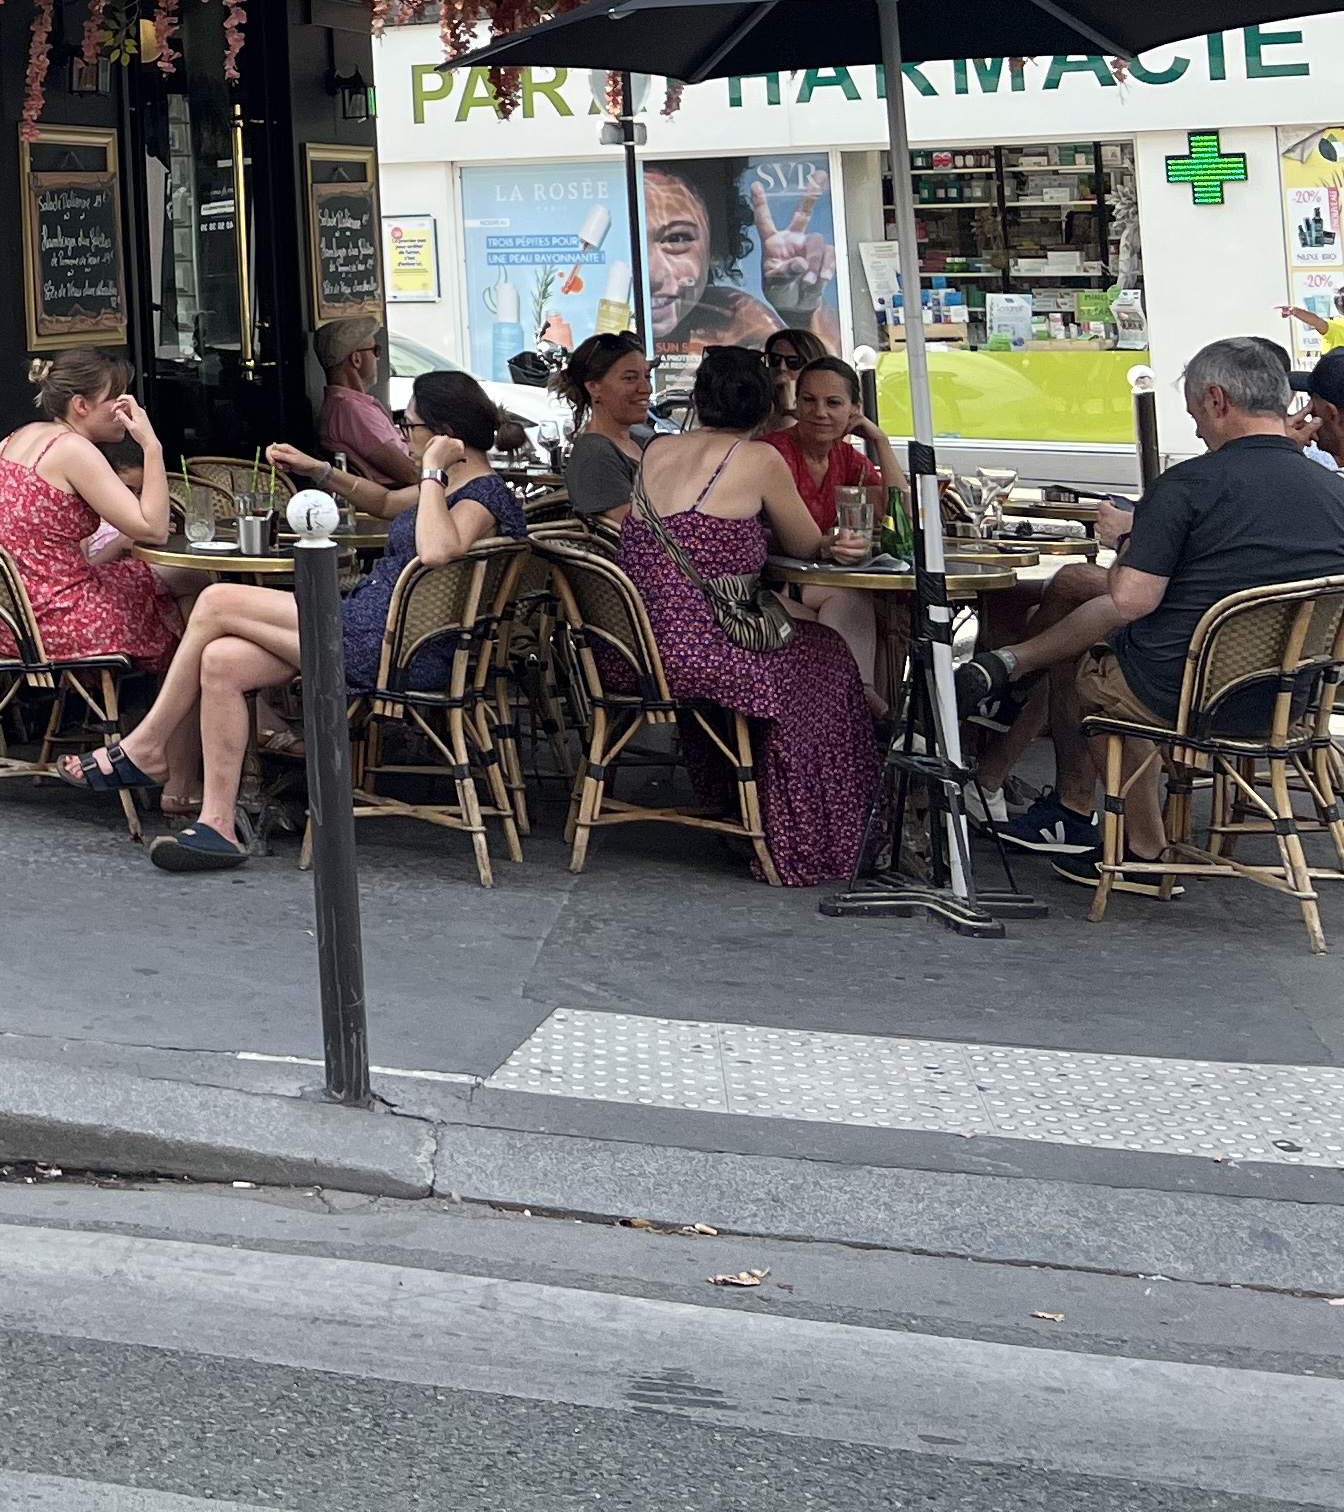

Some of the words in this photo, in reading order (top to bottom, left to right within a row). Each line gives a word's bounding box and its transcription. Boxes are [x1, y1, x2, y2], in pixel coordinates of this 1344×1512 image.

[756, 161, 821, 190] SVR
[496, 184, 524, 202] LA
[533, 177, 610, 201] ROSÉE
[1291, 190, 1322, 204] -20%
[488, 237, 514, 248] TROIS
[515, 235, 550, 248] PÉPITES
[551, 235, 579, 247] POUR
[488, 253, 508, 265] UNE
[509, 252, 533, 264] PEAU
[534, 251, 600, 264] RAYONNANTE
[1303, 274, 1334, 289] -20%
[655, 342, 680, 353] SUN
